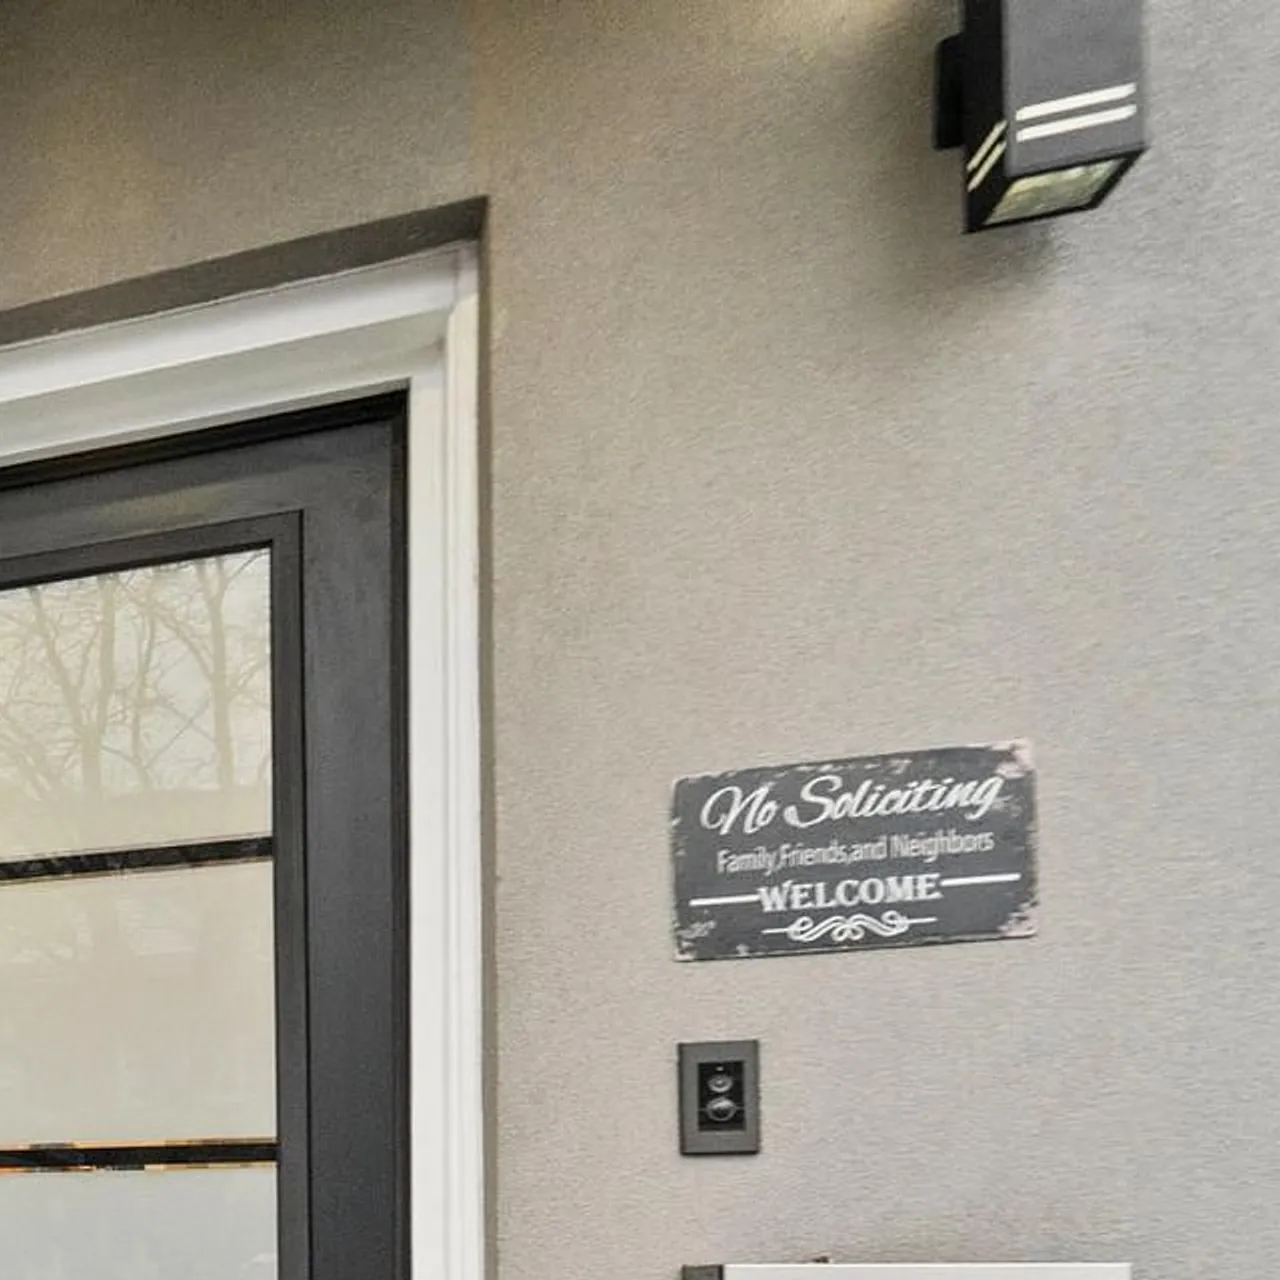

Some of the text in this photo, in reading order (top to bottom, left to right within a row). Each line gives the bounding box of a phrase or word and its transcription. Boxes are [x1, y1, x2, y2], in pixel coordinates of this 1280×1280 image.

[700, 775, 1005, 835] No Soliciting
[892, 829, 995, 863] Neighbors
[757, 873, 943, 913] WELCOME
